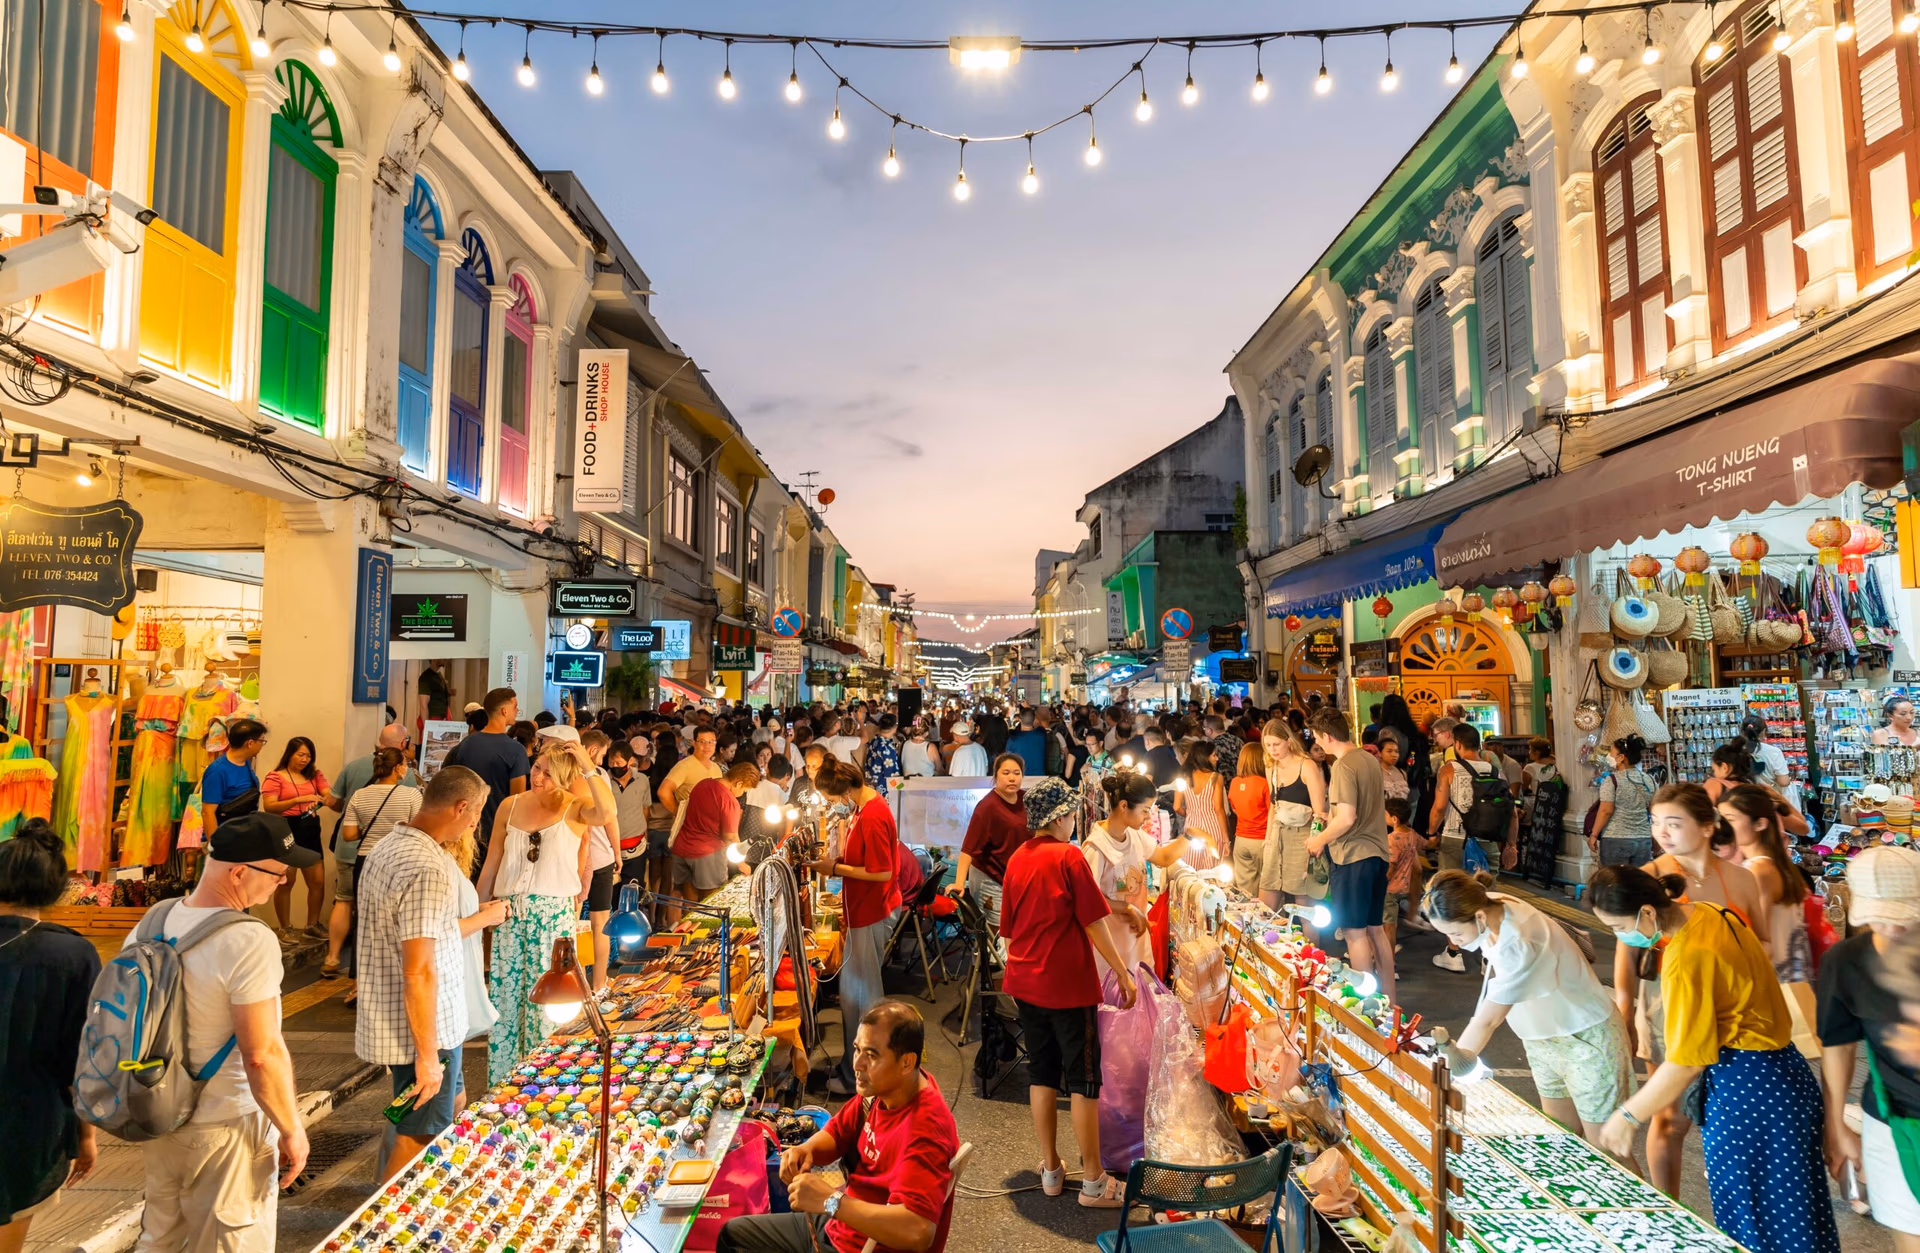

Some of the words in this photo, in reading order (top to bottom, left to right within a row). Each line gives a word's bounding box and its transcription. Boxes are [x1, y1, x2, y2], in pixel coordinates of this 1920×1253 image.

[602, 362, 610, 393] HOUSE
[583, 362, 600, 476] FOOD+DRINKS
[600, 396, 609, 422] SHOP
[1676, 456, 1717, 482] TONG
[1722, 436, 1780, 469] NUENG
[1696, 466, 1757, 496] T-SHIRT
[58, 536, 67, 551] ทู
[107, 532, 119, 548] โค
[9, 552, 51, 562] ELEVEN
[56, 553, 80, 564] TWO
[83, 554, 91, 565] &
[95, 555, 113, 565] CO.
[1385, 563, 1402, 576] Baan
[1404, 555, 1416, 571] 109
[65, 571, 98, 581] 354424
[375, 564, 384, 608] Eleven
[562, 594, 589, 602] Eleven
[590, 594, 607, 602] Two
[608, 595, 615, 603] &
[616, 595, 630, 603] Co.
[374, 611, 382, 636] Two
[373, 640, 380, 650] &
[620, 634, 635, 642] The
[372, 653, 380, 673] Co.
[1671, 694, 1700, 702] Magnet
